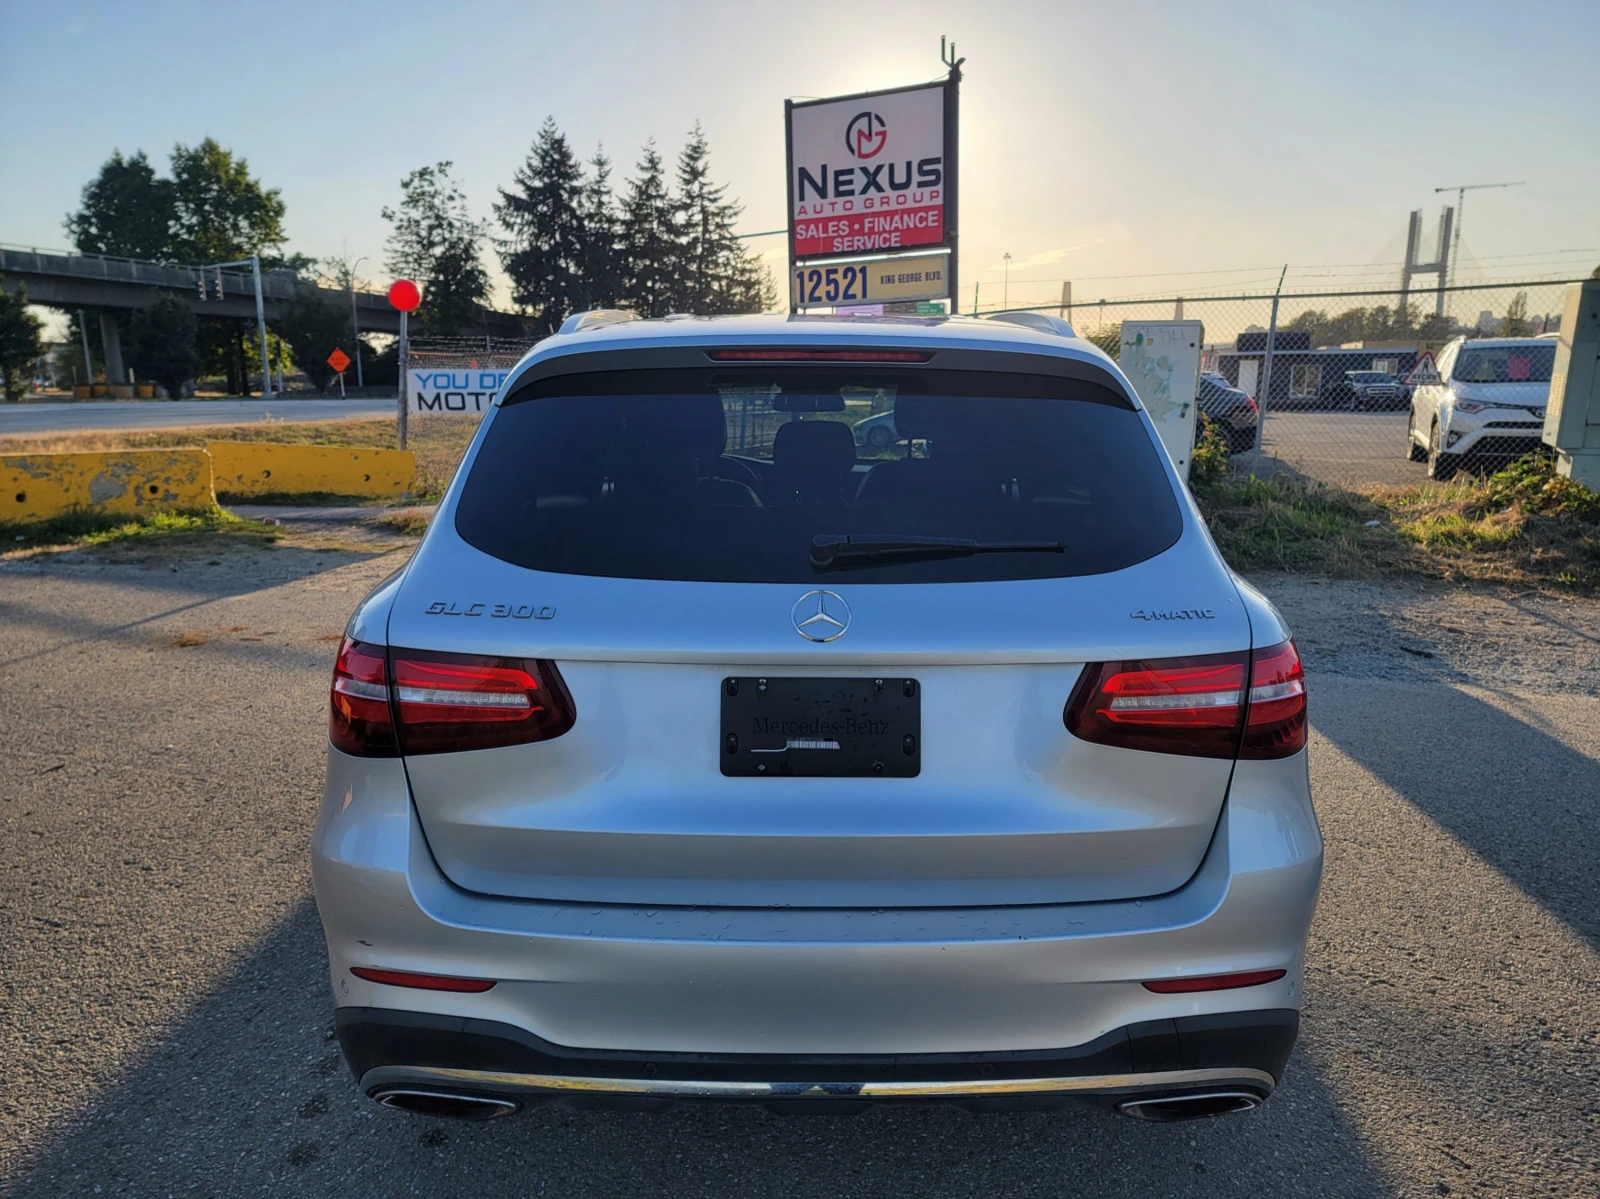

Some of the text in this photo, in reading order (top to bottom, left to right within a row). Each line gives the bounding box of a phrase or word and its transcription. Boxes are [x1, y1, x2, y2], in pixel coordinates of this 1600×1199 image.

[797, 157, 942, 202] NEXUS
[797, 190, 940, 216] AUTO GROUP
[796, 211, 939, 240] SALES FINANCE
[832, 232, 902, 253] SERVICE
[796, 265, 868, 304] 12521
[880, 274, 896, 285] KING
[898, 272, 922, 284] GEORGE
[415, 373, 469, 390] YOU
[425, 602, 557, 620] GLC 300
[1129, 607, 1216, 621] 4MATIC
[752, 717, 890, 736] Mercedes-Benz
